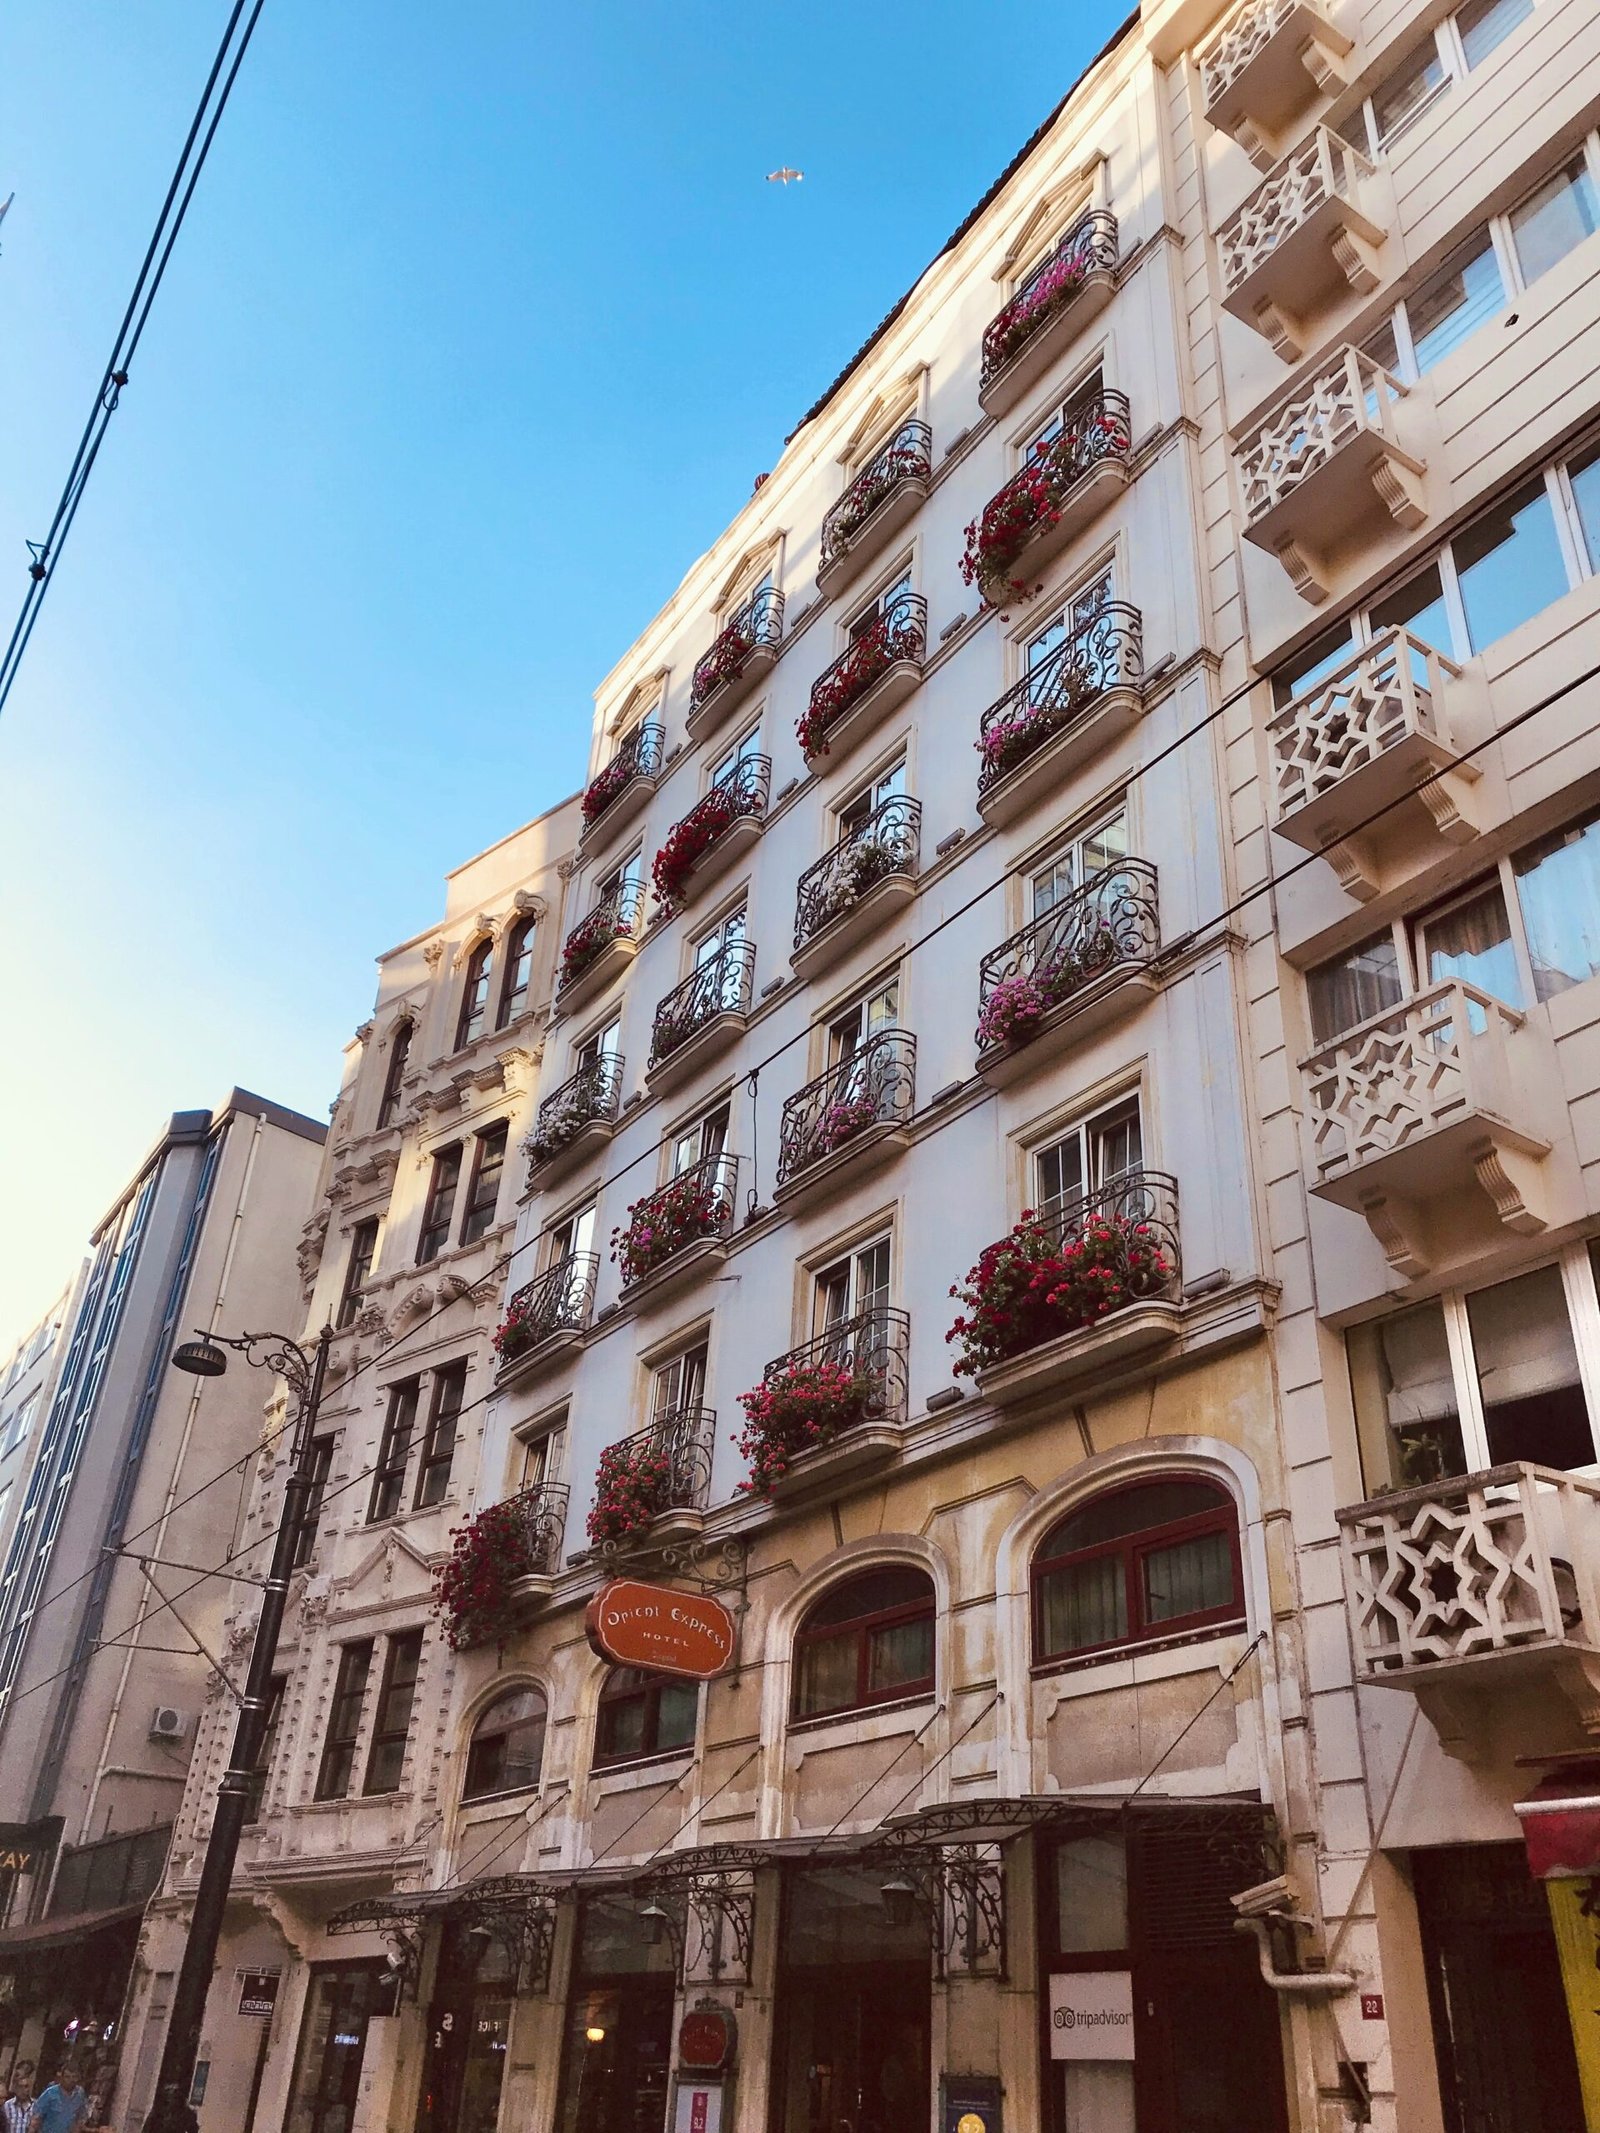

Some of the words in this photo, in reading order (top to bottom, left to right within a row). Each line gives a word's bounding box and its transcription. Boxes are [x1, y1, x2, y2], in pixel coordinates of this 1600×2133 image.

[671, 1607, 725, 1649] Express
[642, 1631, 690, 1648] HOTEL
[1365, 2000, 1378, 2014] 22
[1076, 2008, 1130, 2029] tripadvisor
